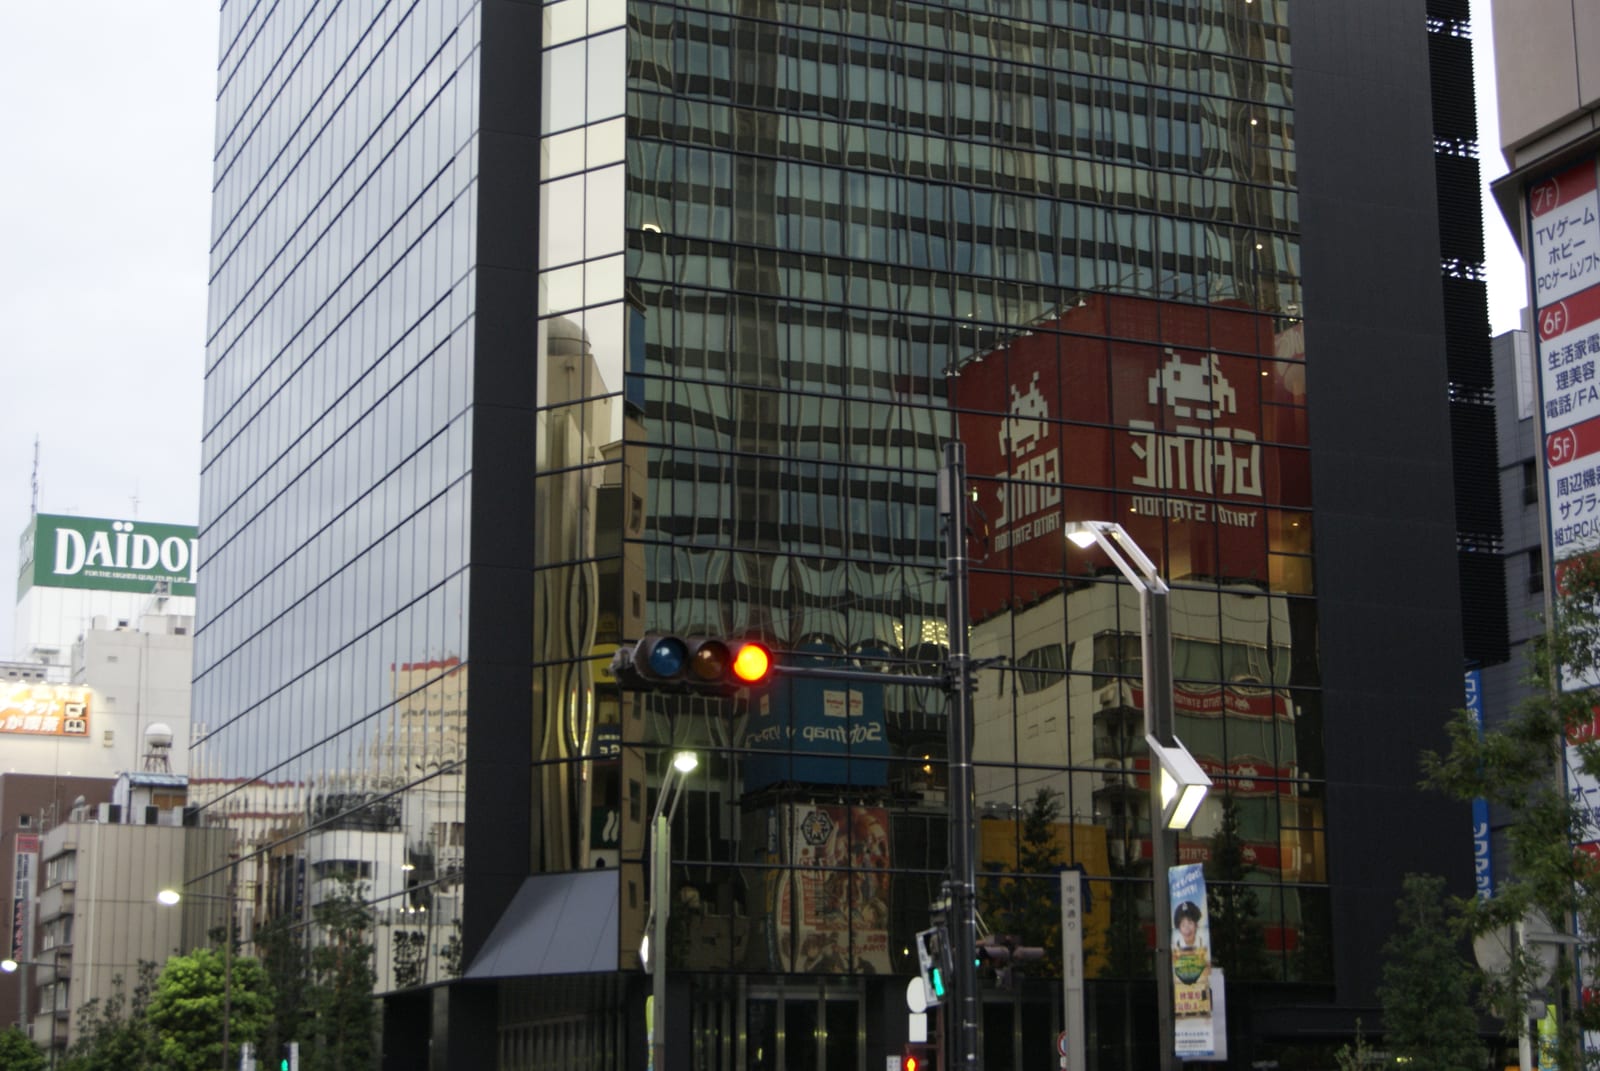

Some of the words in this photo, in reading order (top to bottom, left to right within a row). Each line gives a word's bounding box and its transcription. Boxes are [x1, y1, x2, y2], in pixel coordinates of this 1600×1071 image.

[1535, 186, 1553, 212] 7F
[1536, 206, 1595, 246] TVゲーム
[1548, 238, 1586, 265] ホビー
[1537, 252, 1600, 294] PCゲームソフト
[1543, 311, 1563, 335] 6F
[1548, 333, 1600, 371] 生活家電
[1556, 360, 1595, 391] 理美容
[1545, 382, 1600, 418] 電話/FA
[1551, 437, 1571, 462] 5F
[1559, 492, 1600, 520] サプラ
